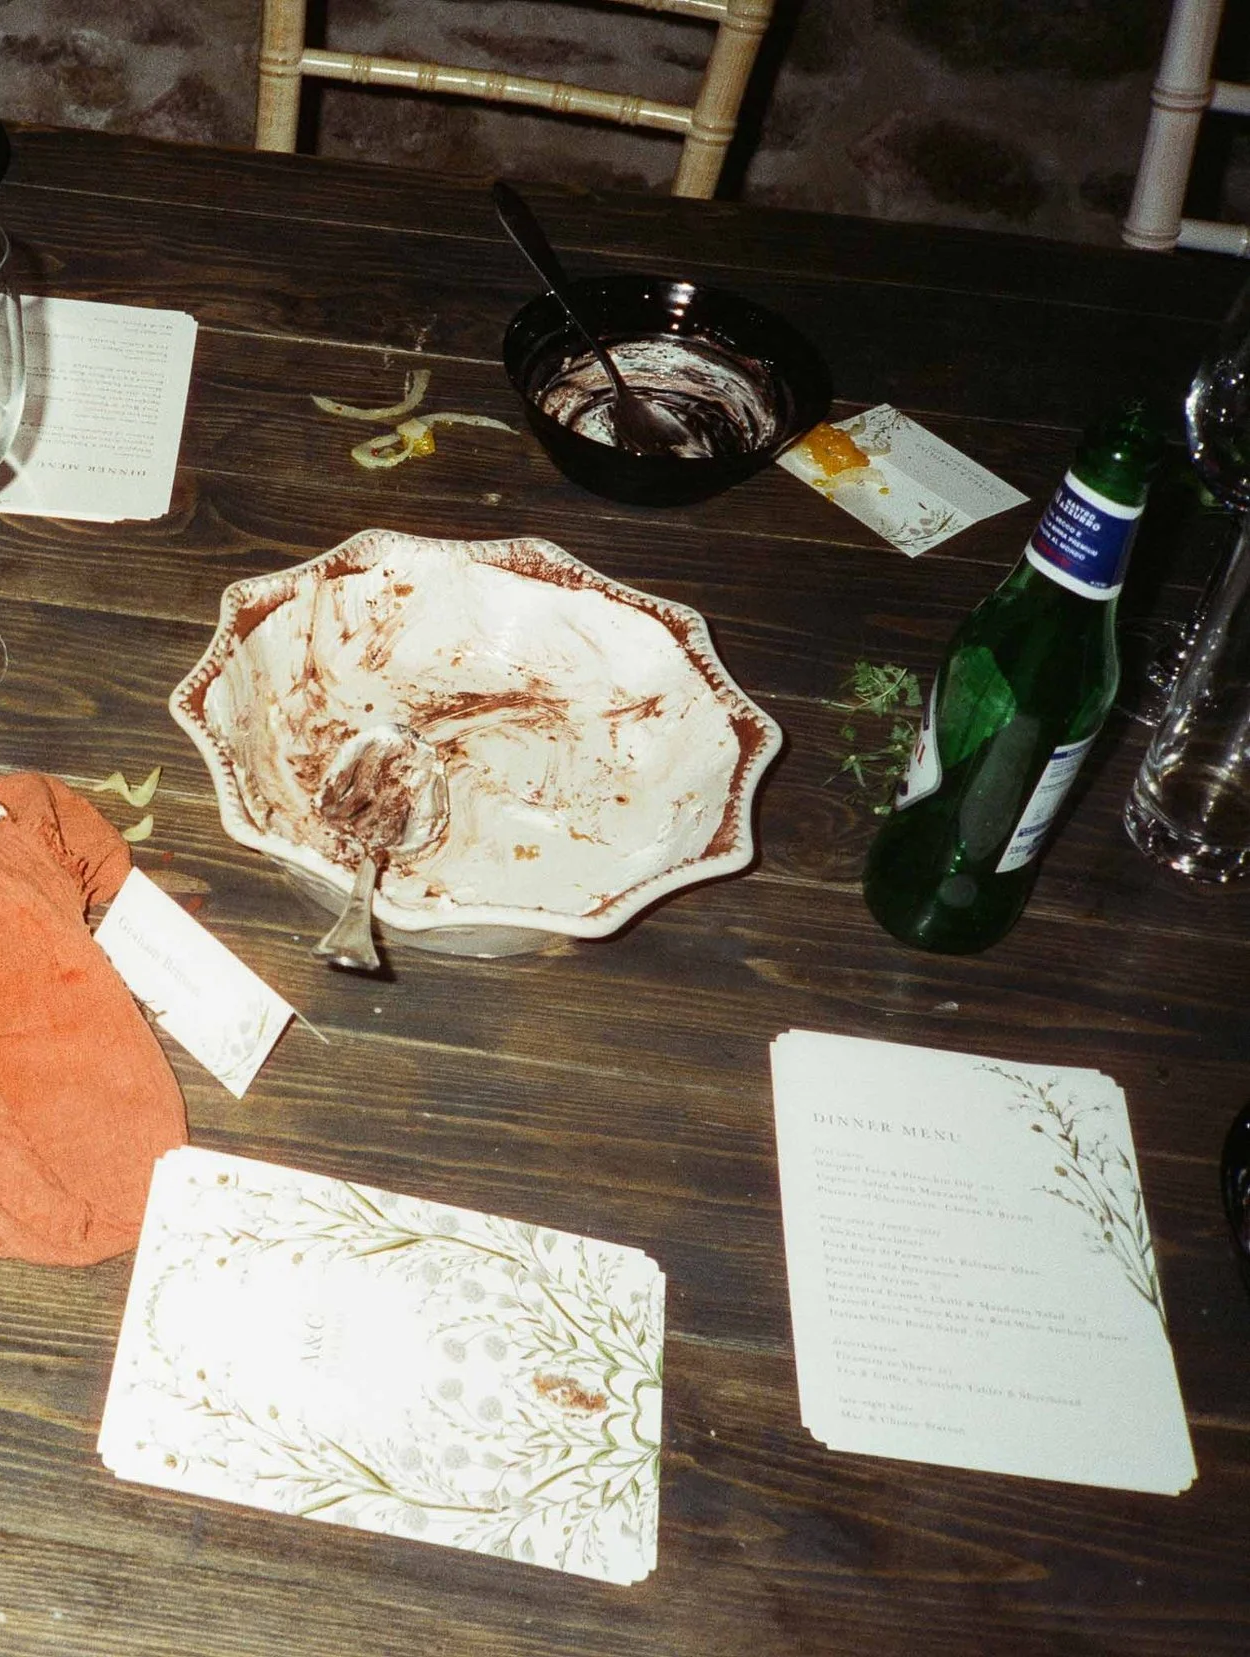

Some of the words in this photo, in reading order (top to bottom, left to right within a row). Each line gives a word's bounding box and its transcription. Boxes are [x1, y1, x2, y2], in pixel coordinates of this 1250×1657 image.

[87, 463, 147, 477] DINNER
[1059, 500, 1101, 531] AZZURRO
[813, 1112, 892, 1133] DINNER
[902, 1125, 961, 1143] MENU
